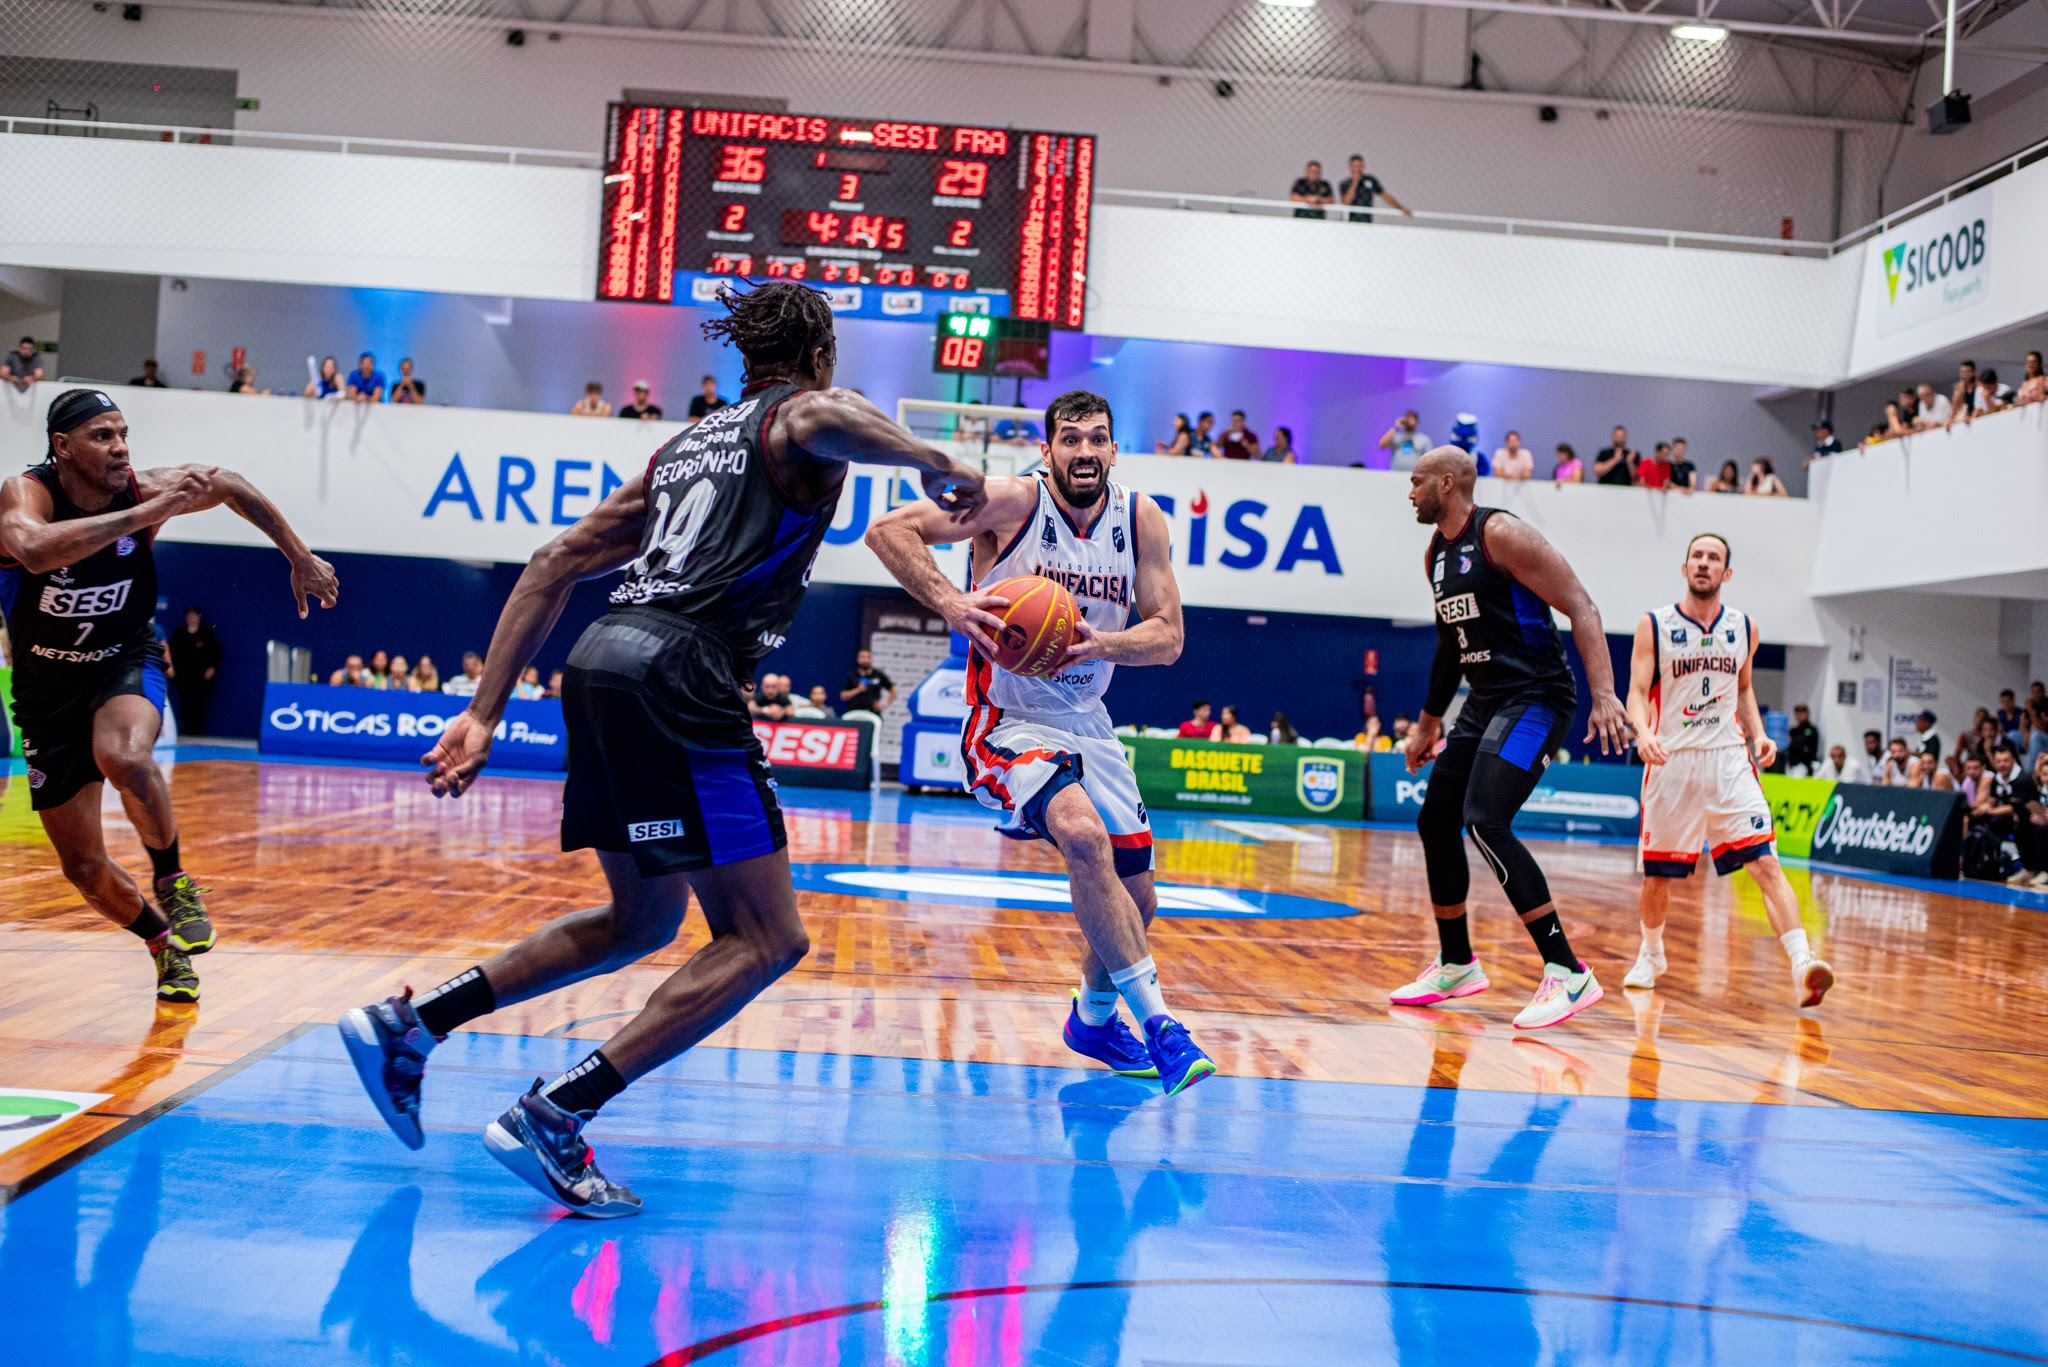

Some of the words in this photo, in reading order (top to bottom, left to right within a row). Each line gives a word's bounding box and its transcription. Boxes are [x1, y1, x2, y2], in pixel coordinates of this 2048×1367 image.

[692, 110, 828, 142] UNIFACIS
[873, 122, 940, 150] SESI
[953, 127, 1008, 155] FRA
[718, 144, 767, 182] 36
[838, 174, 859, 200] 3
[937, 160, 988, 196] 29
[724, 204, 746, 232] 2
[951, 219, 973, 246] 2
[1906, 219, 1985, 293] SICOOB
[941, 336, 984, 368] 08
[634, 477, 718, 575] 14
[1047, 560, 1119, 574] BASQUET
[49, 585, 126, 614] SESI
[1441, 597, 1471, 621] SESI
[73, 622, 95, 646] 7
[1672, 657, 1737, 679] UNIFACISA
[1702, 676, 1710, 697] 8
[270, 702, 391, 736] ÓTICAS
[511, 721, 558, 745] Prime
[1170, 748, 1263, 773] BASQUETE
[1185, 769, 1248, 793] BRASIL
[635, 822, 678, 839] SESI
[1831, 806, 1934, 855] Sportsbet.io
